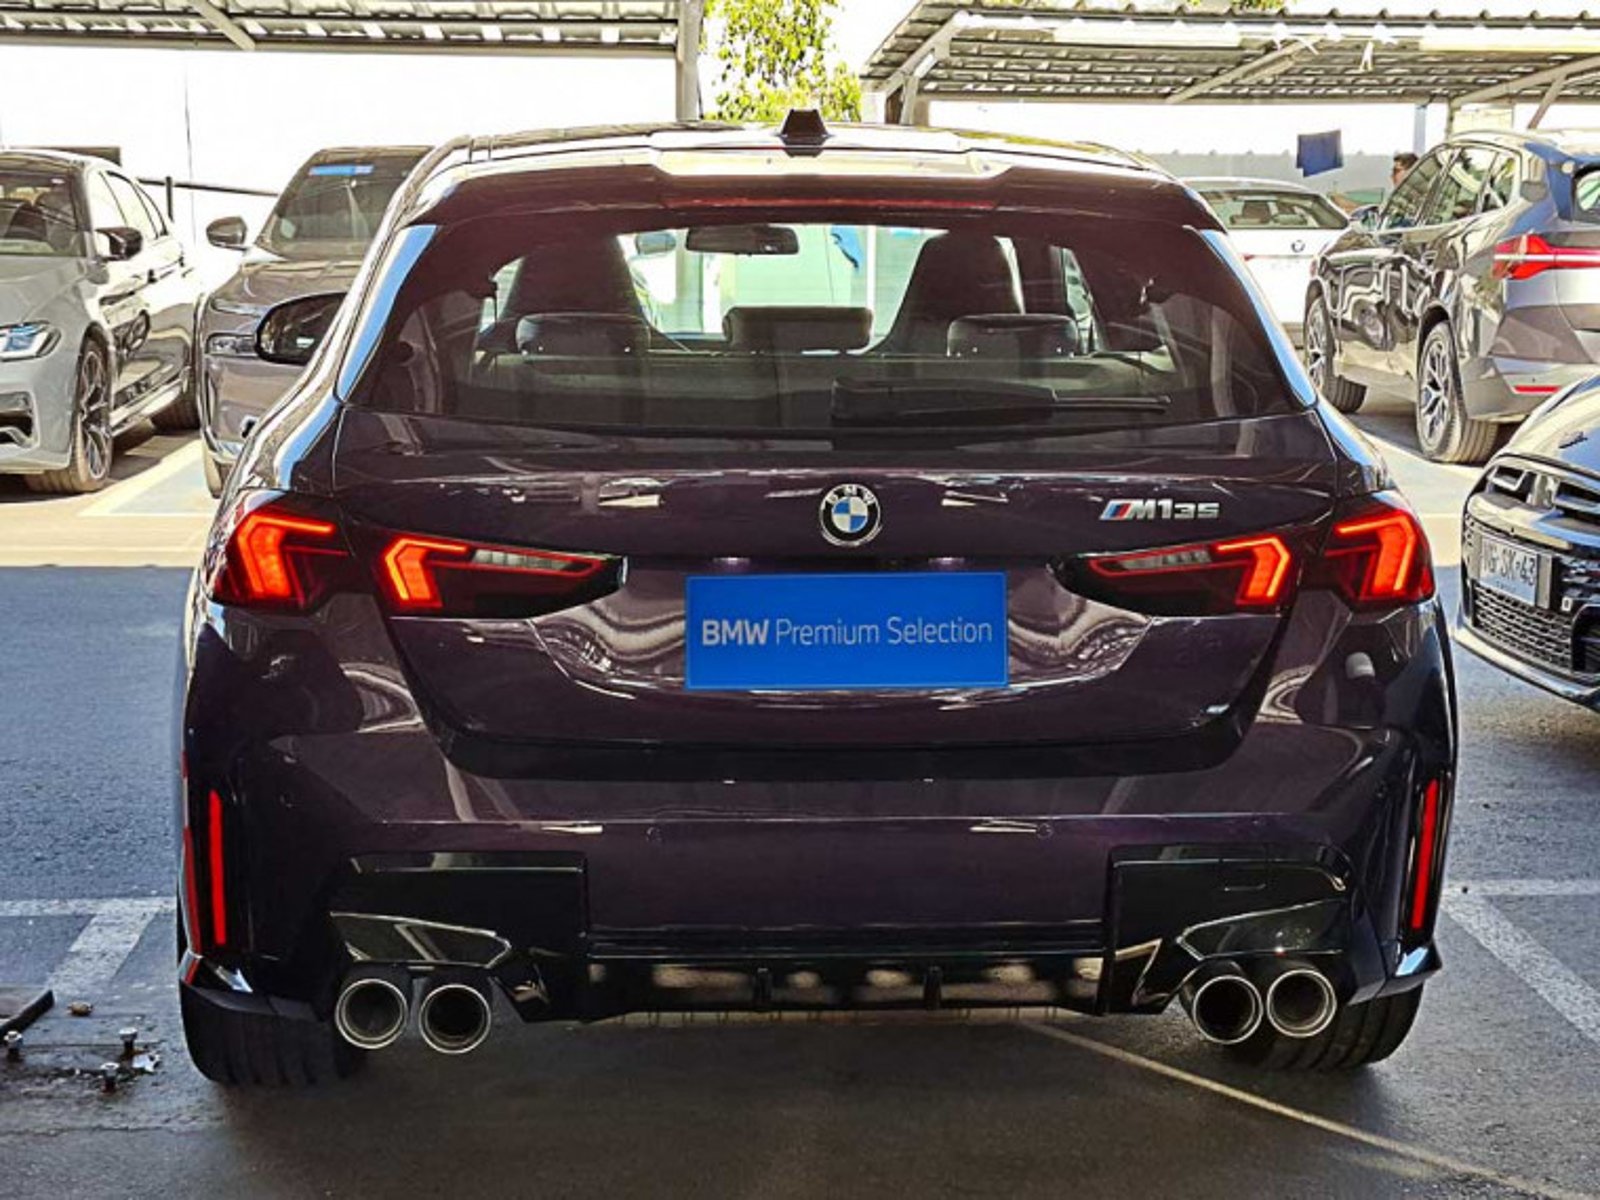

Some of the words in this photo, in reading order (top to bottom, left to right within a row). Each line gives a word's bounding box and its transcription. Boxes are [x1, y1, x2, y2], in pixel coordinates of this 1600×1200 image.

[1127, 498, 1220, 520] M135
[702, 619, 769, 645] BMW
[776, 618, 880, 645] Premium
[886, 616, 993, 643] Selection
